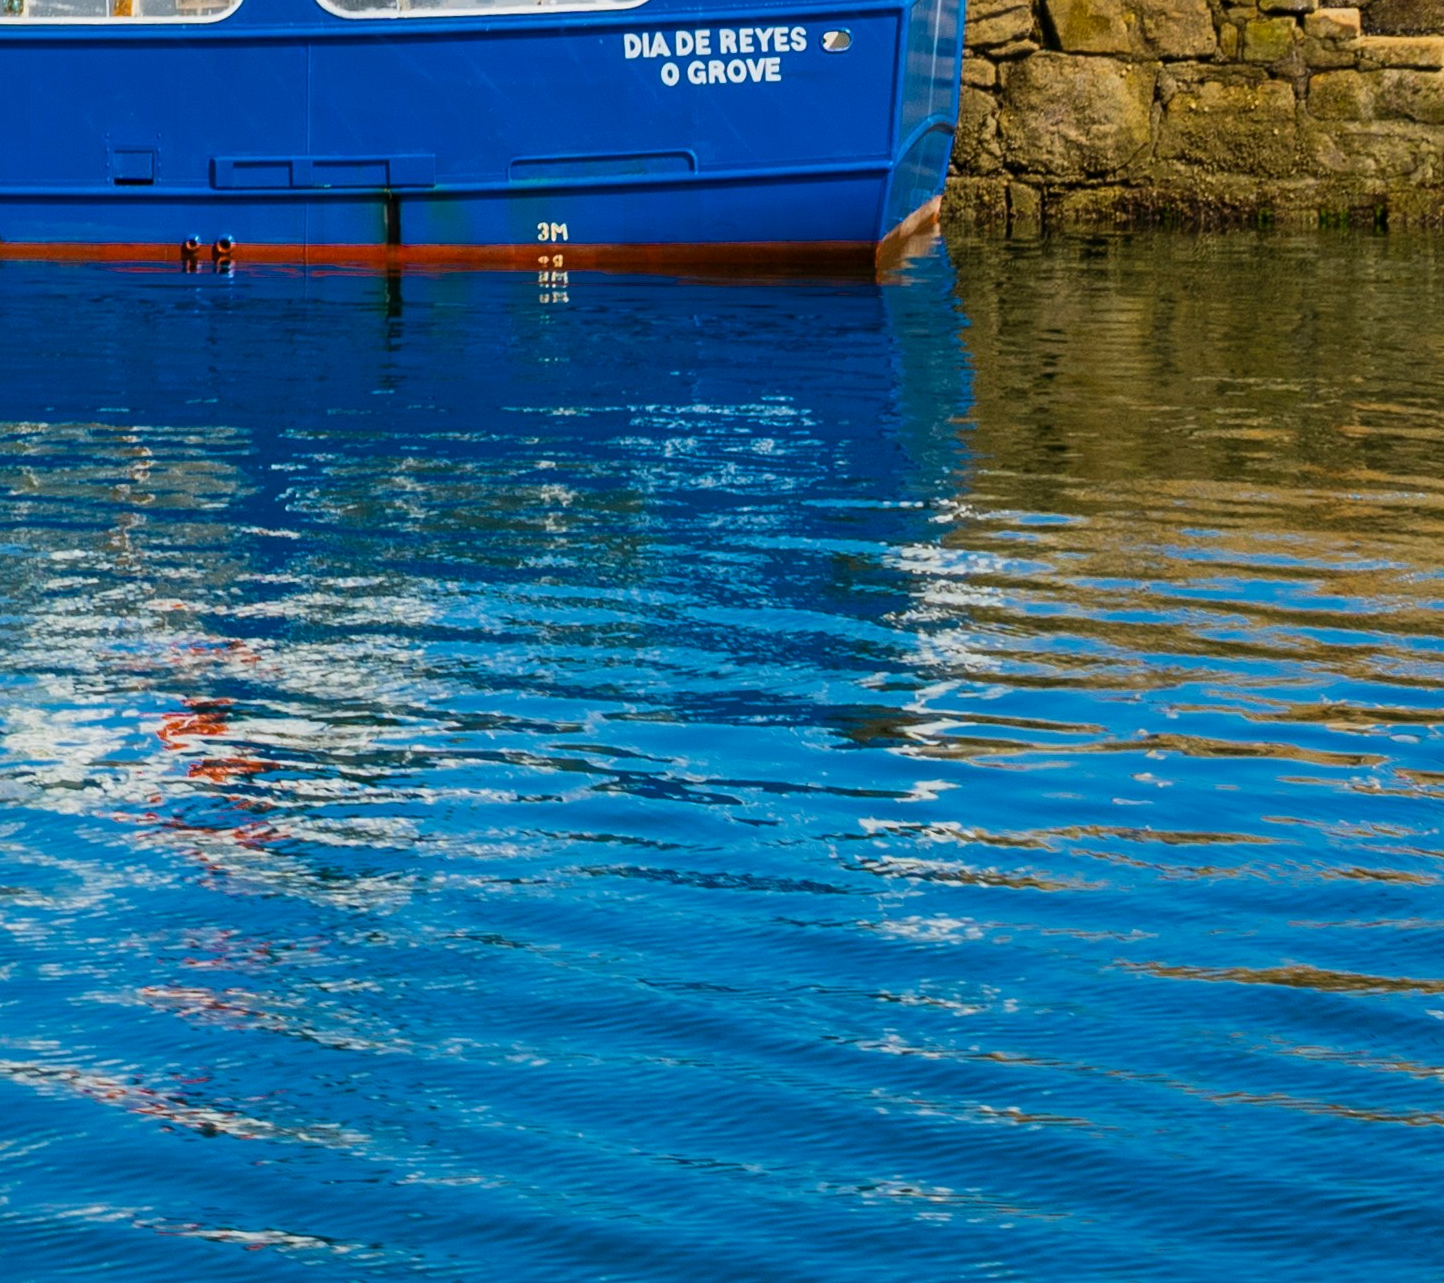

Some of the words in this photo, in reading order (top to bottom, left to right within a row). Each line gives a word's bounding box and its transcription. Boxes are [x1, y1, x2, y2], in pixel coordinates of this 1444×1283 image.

[624, 31, 671, 59] DIA
[675, 29, 712, 56] DE
[719, 26, 807, 54] REYES
[687, 57, 782, 85] GROVE
[537, 222, 569, 242] 3M
